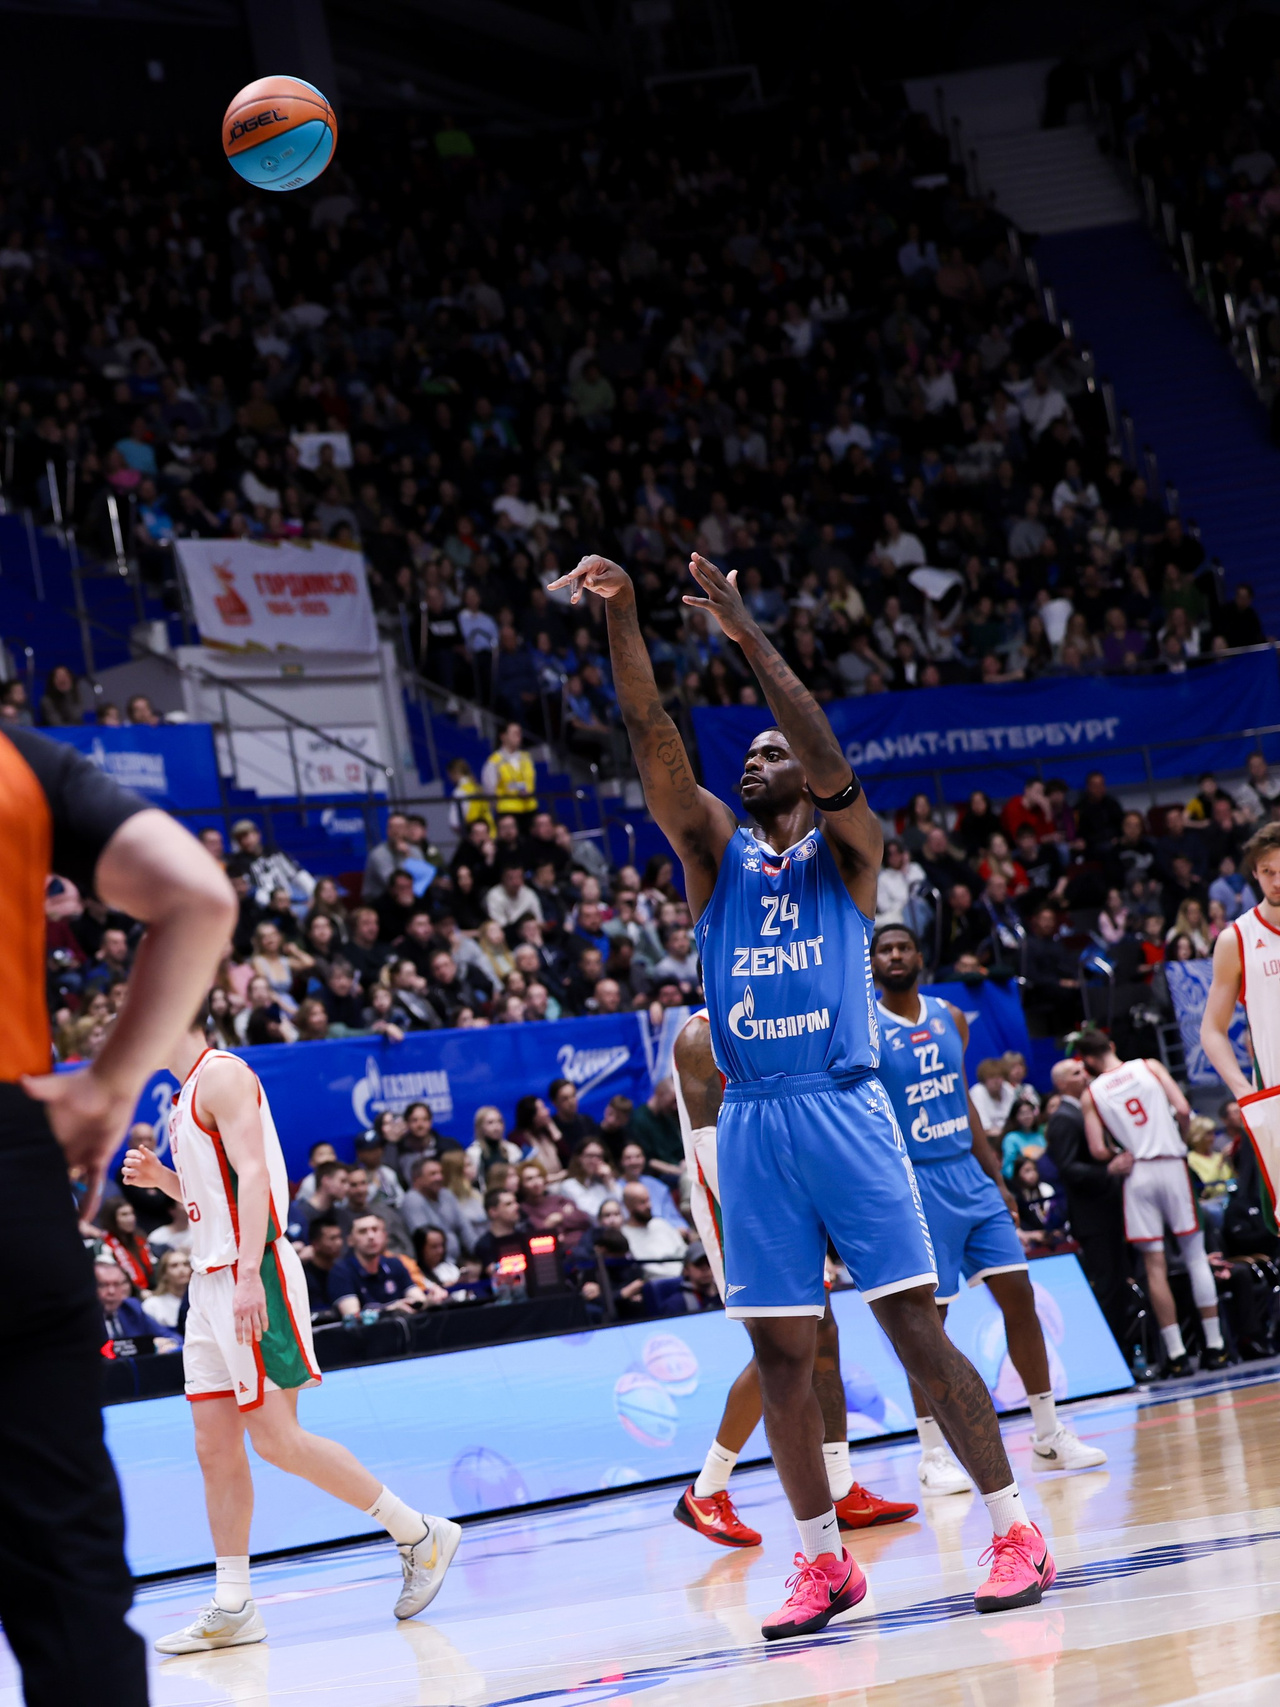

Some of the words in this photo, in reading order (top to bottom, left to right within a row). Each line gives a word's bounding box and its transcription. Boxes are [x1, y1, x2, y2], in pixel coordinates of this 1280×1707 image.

[228, 108, 289, 146] JÖGEL
[845, 717, 1120, 767] САНКТ-ПЕТЕРБУРГ
[760, 893, 800, 936] 24
[731, 935, 824, 977] ZENIT
[1263, 959, 1280, 977] LO
[913, 1042, 945, 1076] 22
[1125, 1097, 1149, 1128] 9
